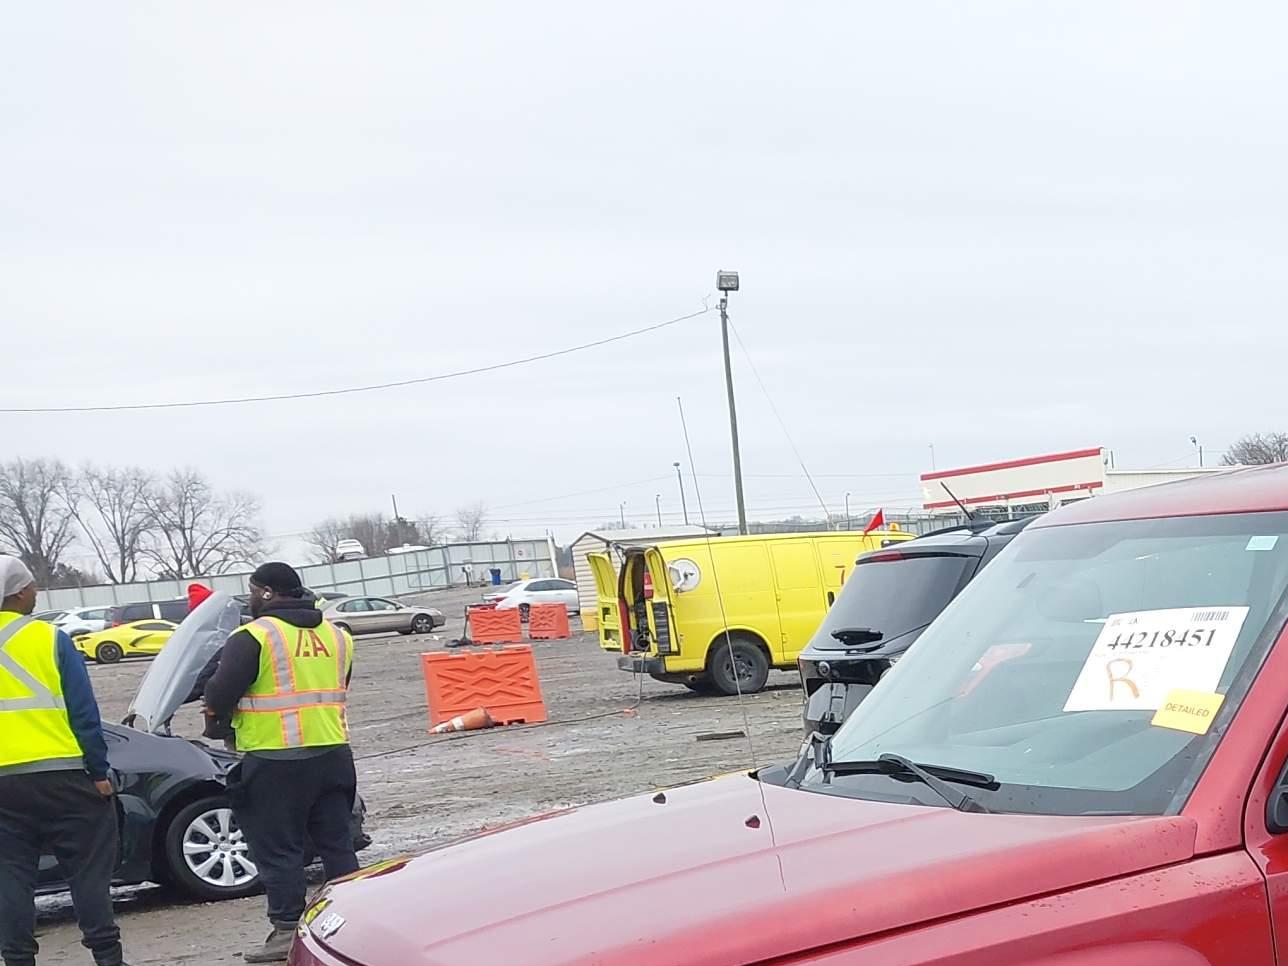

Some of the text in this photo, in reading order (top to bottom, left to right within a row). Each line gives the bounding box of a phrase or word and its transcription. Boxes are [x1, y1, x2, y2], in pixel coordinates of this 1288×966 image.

[1107, 628, 1217, 650] 44218451
[1106, 657, 1140, 702] R
[1164, 702, 1210, 718] DETAILED
